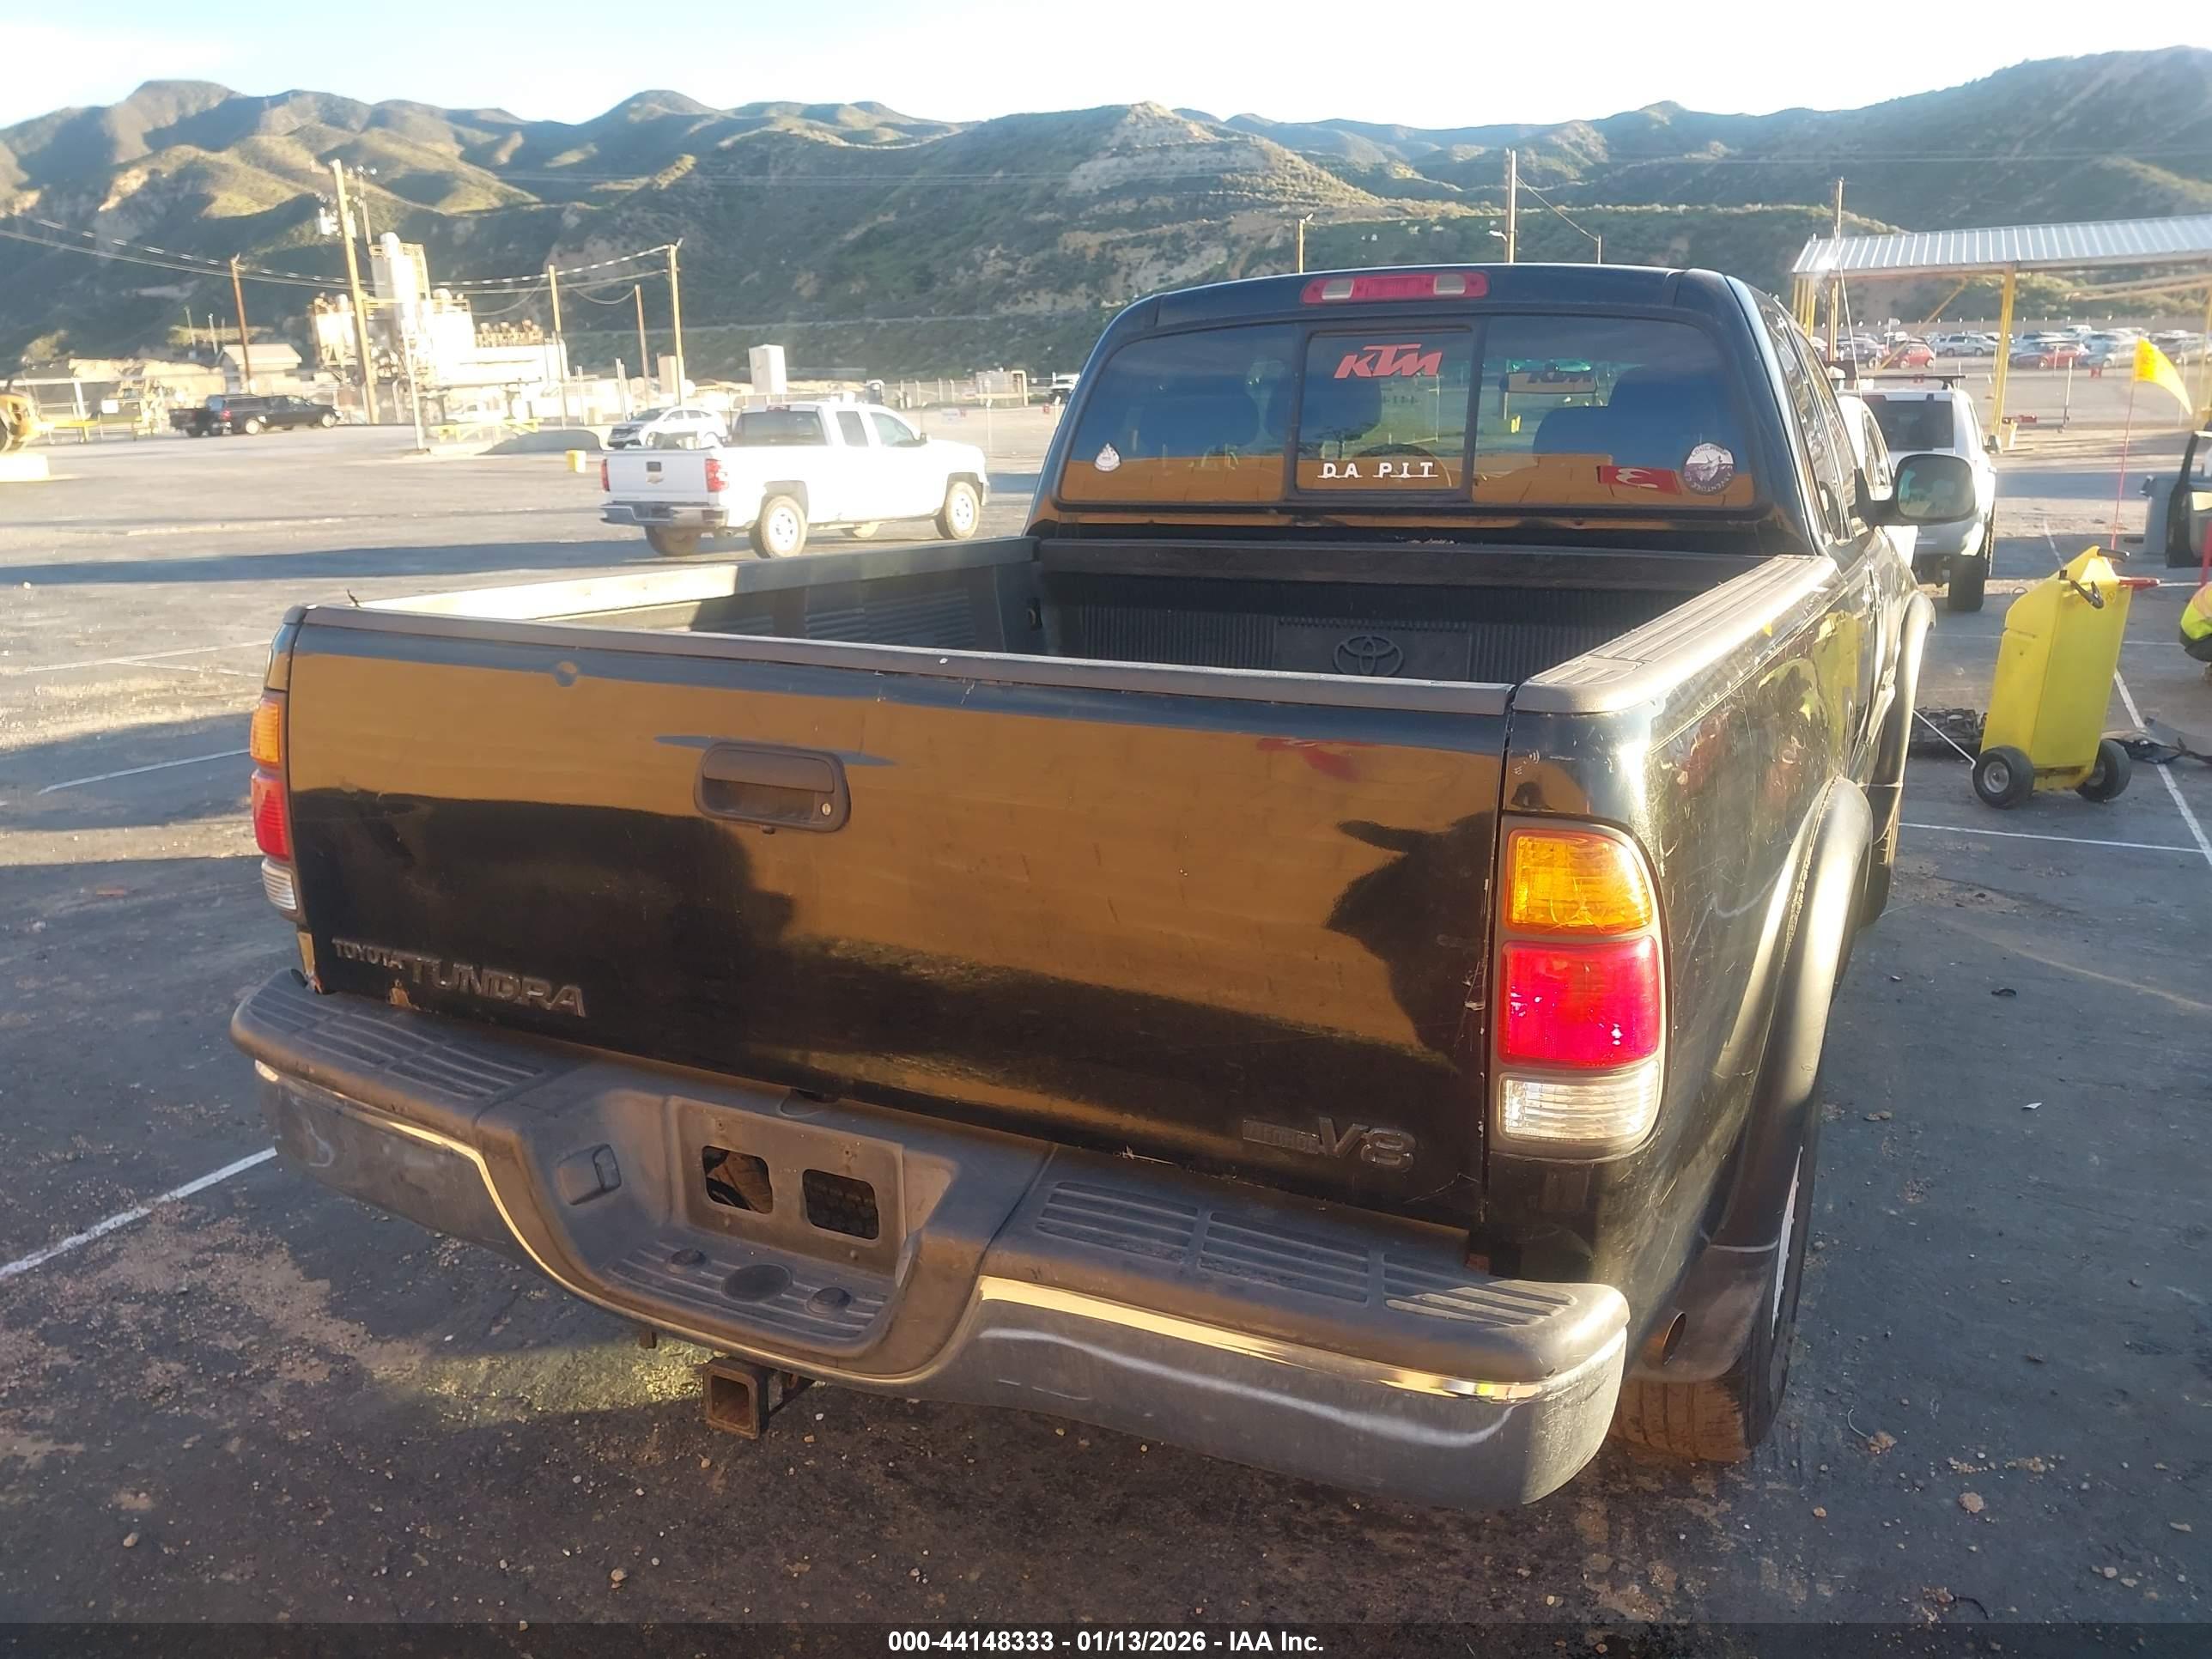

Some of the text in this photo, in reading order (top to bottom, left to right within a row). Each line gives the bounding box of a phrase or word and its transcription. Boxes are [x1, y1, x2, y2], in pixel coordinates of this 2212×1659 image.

[1333, 343, 1443, 379] KTM
[1318, 462, 1439, 478] DA PIT
[331, 938, 586, 1018] TOYOTA TUNDRA
[1319, 1116, 1416, 1171] V8
